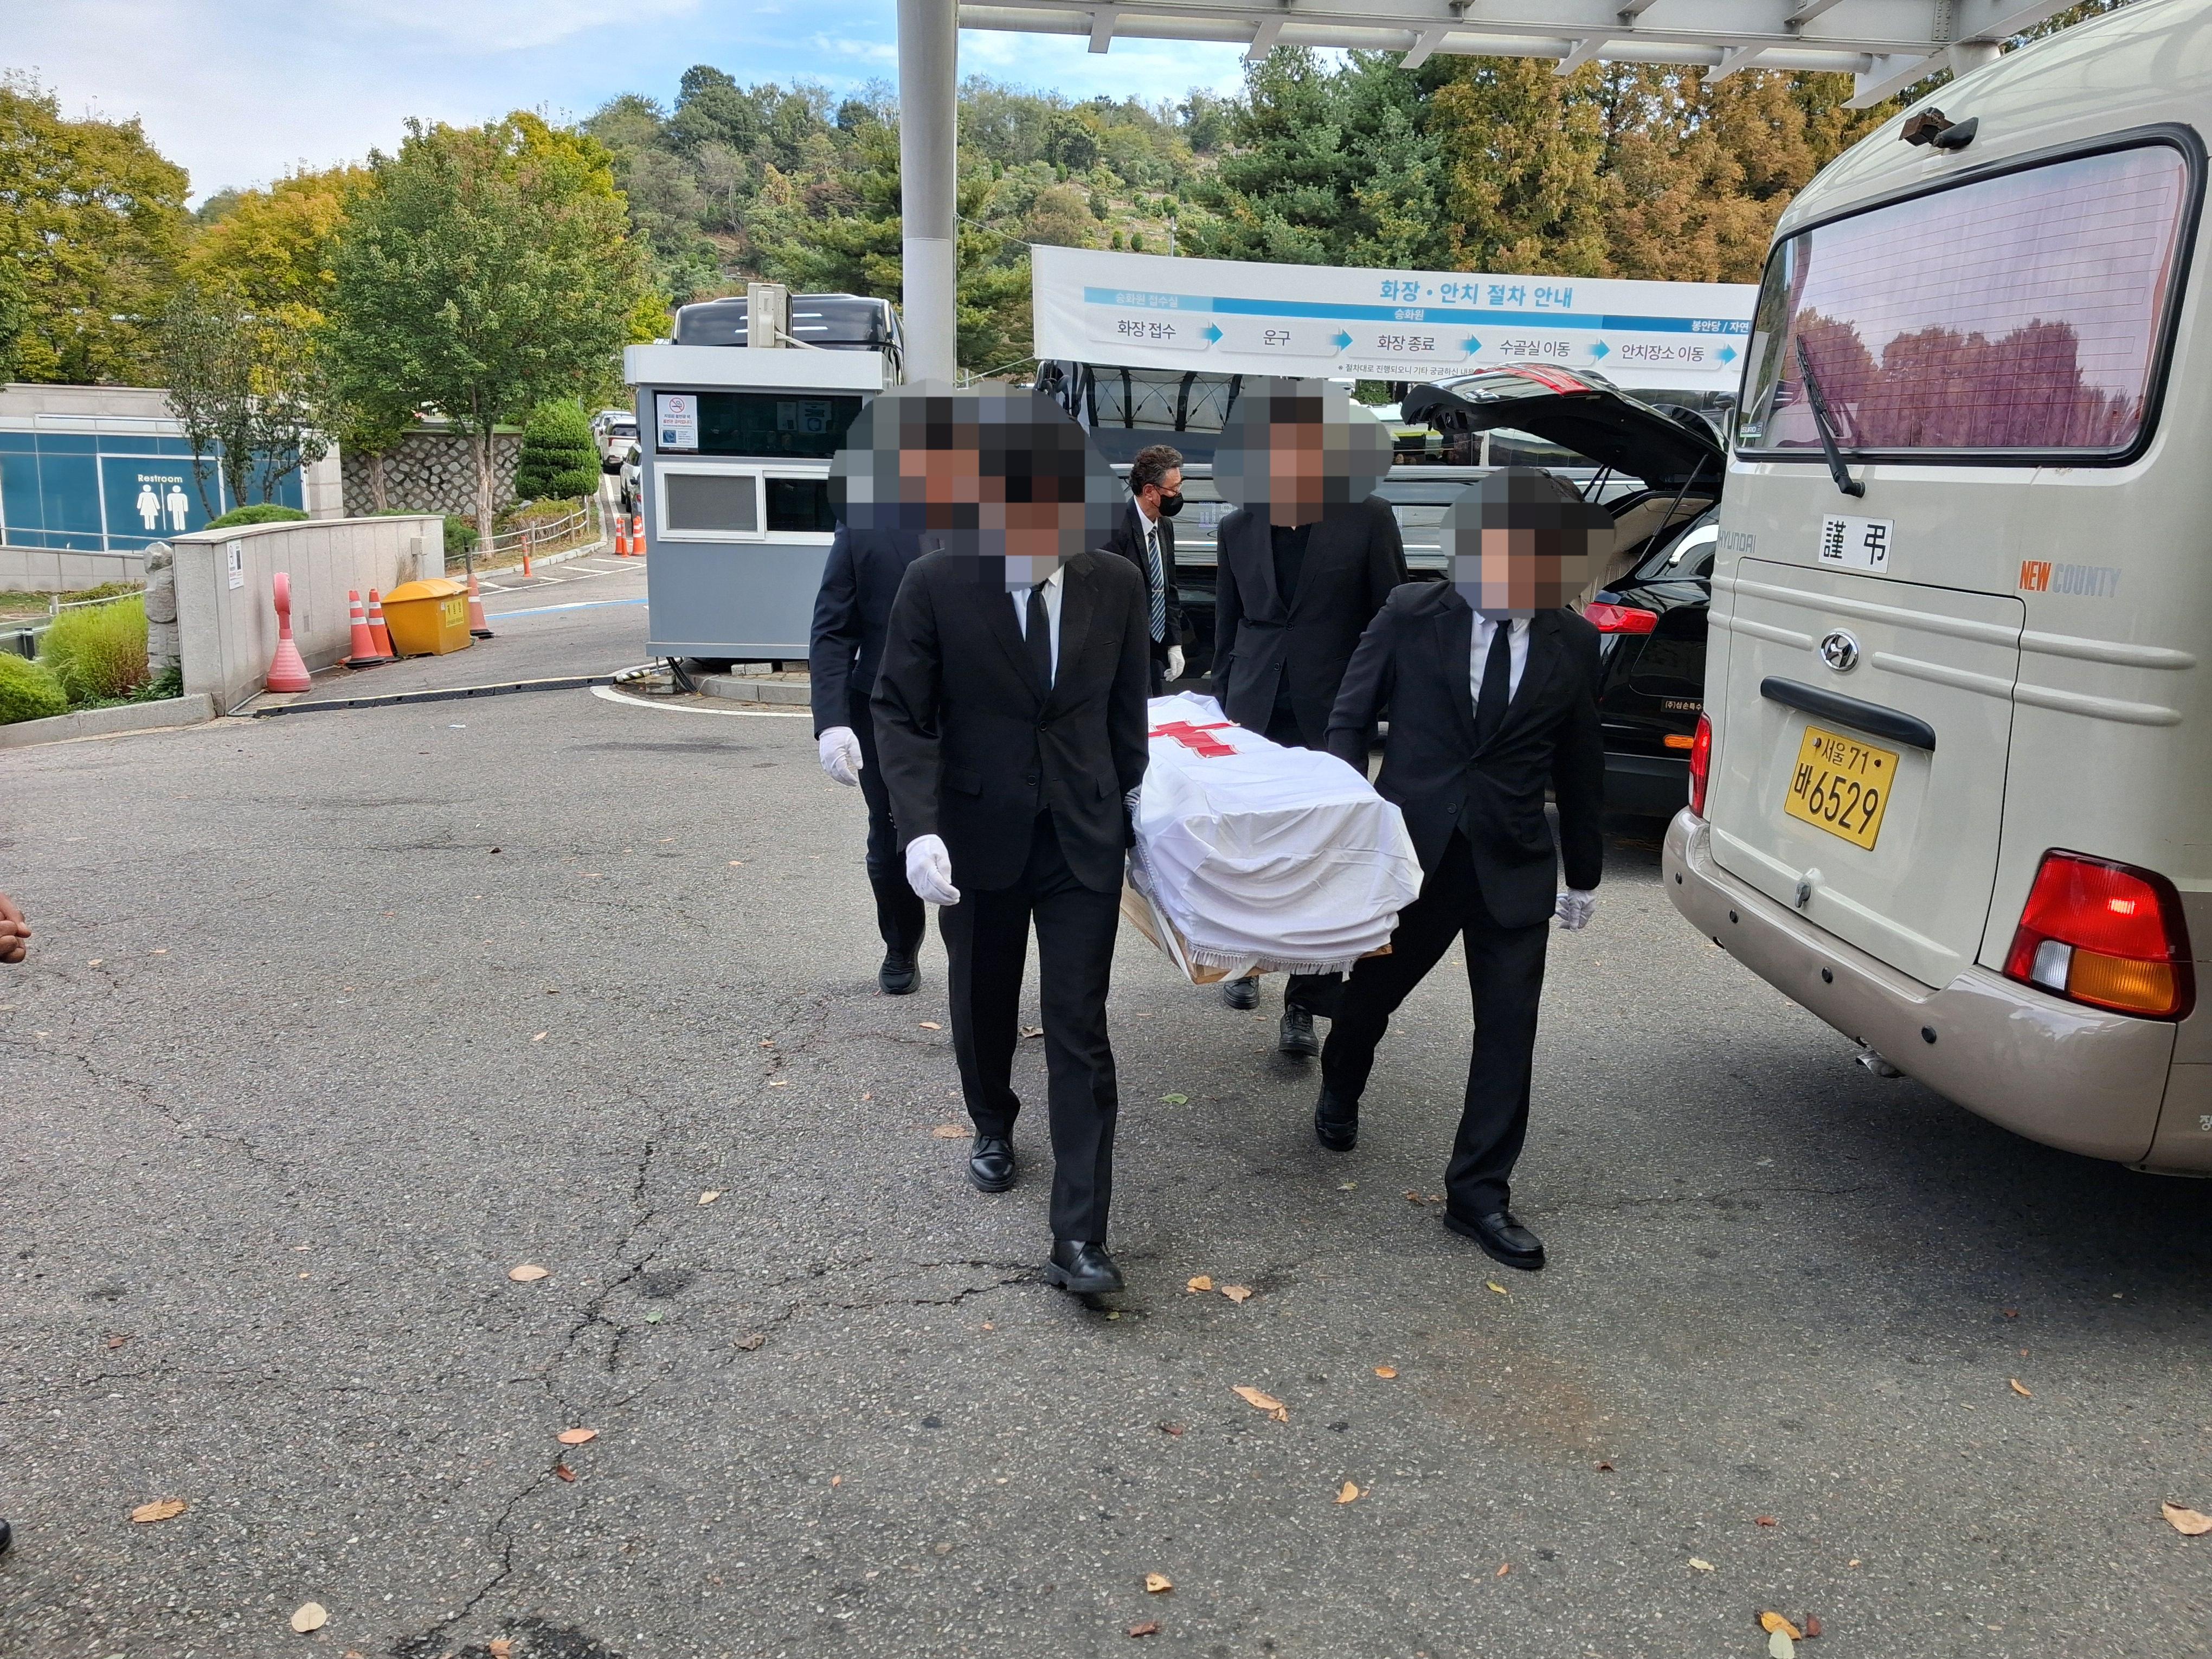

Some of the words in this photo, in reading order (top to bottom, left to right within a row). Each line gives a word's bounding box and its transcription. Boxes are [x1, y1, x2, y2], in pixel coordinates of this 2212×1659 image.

[1116, 293, 1145, 305] 승화원
[1149, 295, 1178, 308] 접수실
[1380, 280, 1420, 302] 화장
[1441, 282, 1479, 305] 안치
[1487, 285, 1526, 306] 절차
[1534, 286, 1573, 308] 안내
[1394, 308, 1424, 320] 승화원
[1117, 320, 1146, 337] 화장
[1148, 323, 1176, 339] 접수
[1692, 320, 1721, 332] 봉안당
[1263, 330, 1291, 346] 운구
[1377, 335, 1405, 351] 화장
[1408, 336, 1435, 351] 종료
[1500, 339, 1540, 356] 수골실
[1544, 341, 1571, 357] 이동
[1622, 344, 1675, 361] 안치장소
[1679, 346, 1705, 362] 이동
[1346, 364, 1374, 372] 절차대로
[1376, 365, 1412, 374] 진행되오니
[1413, 366, 1427, 375] 기타
[1430, 366, 1458, 376] 궁금하신
[137, 474, 183, 483] Restroom
[1718, 530, 1757, 553] HYUNDAI
[2020, 560, 2052, 591] NEW
[2053, 563, 2122, 598] COUNTY
[1822, 738, 1846, 766] 서울
[1848, 747, 1870, 775] 71
